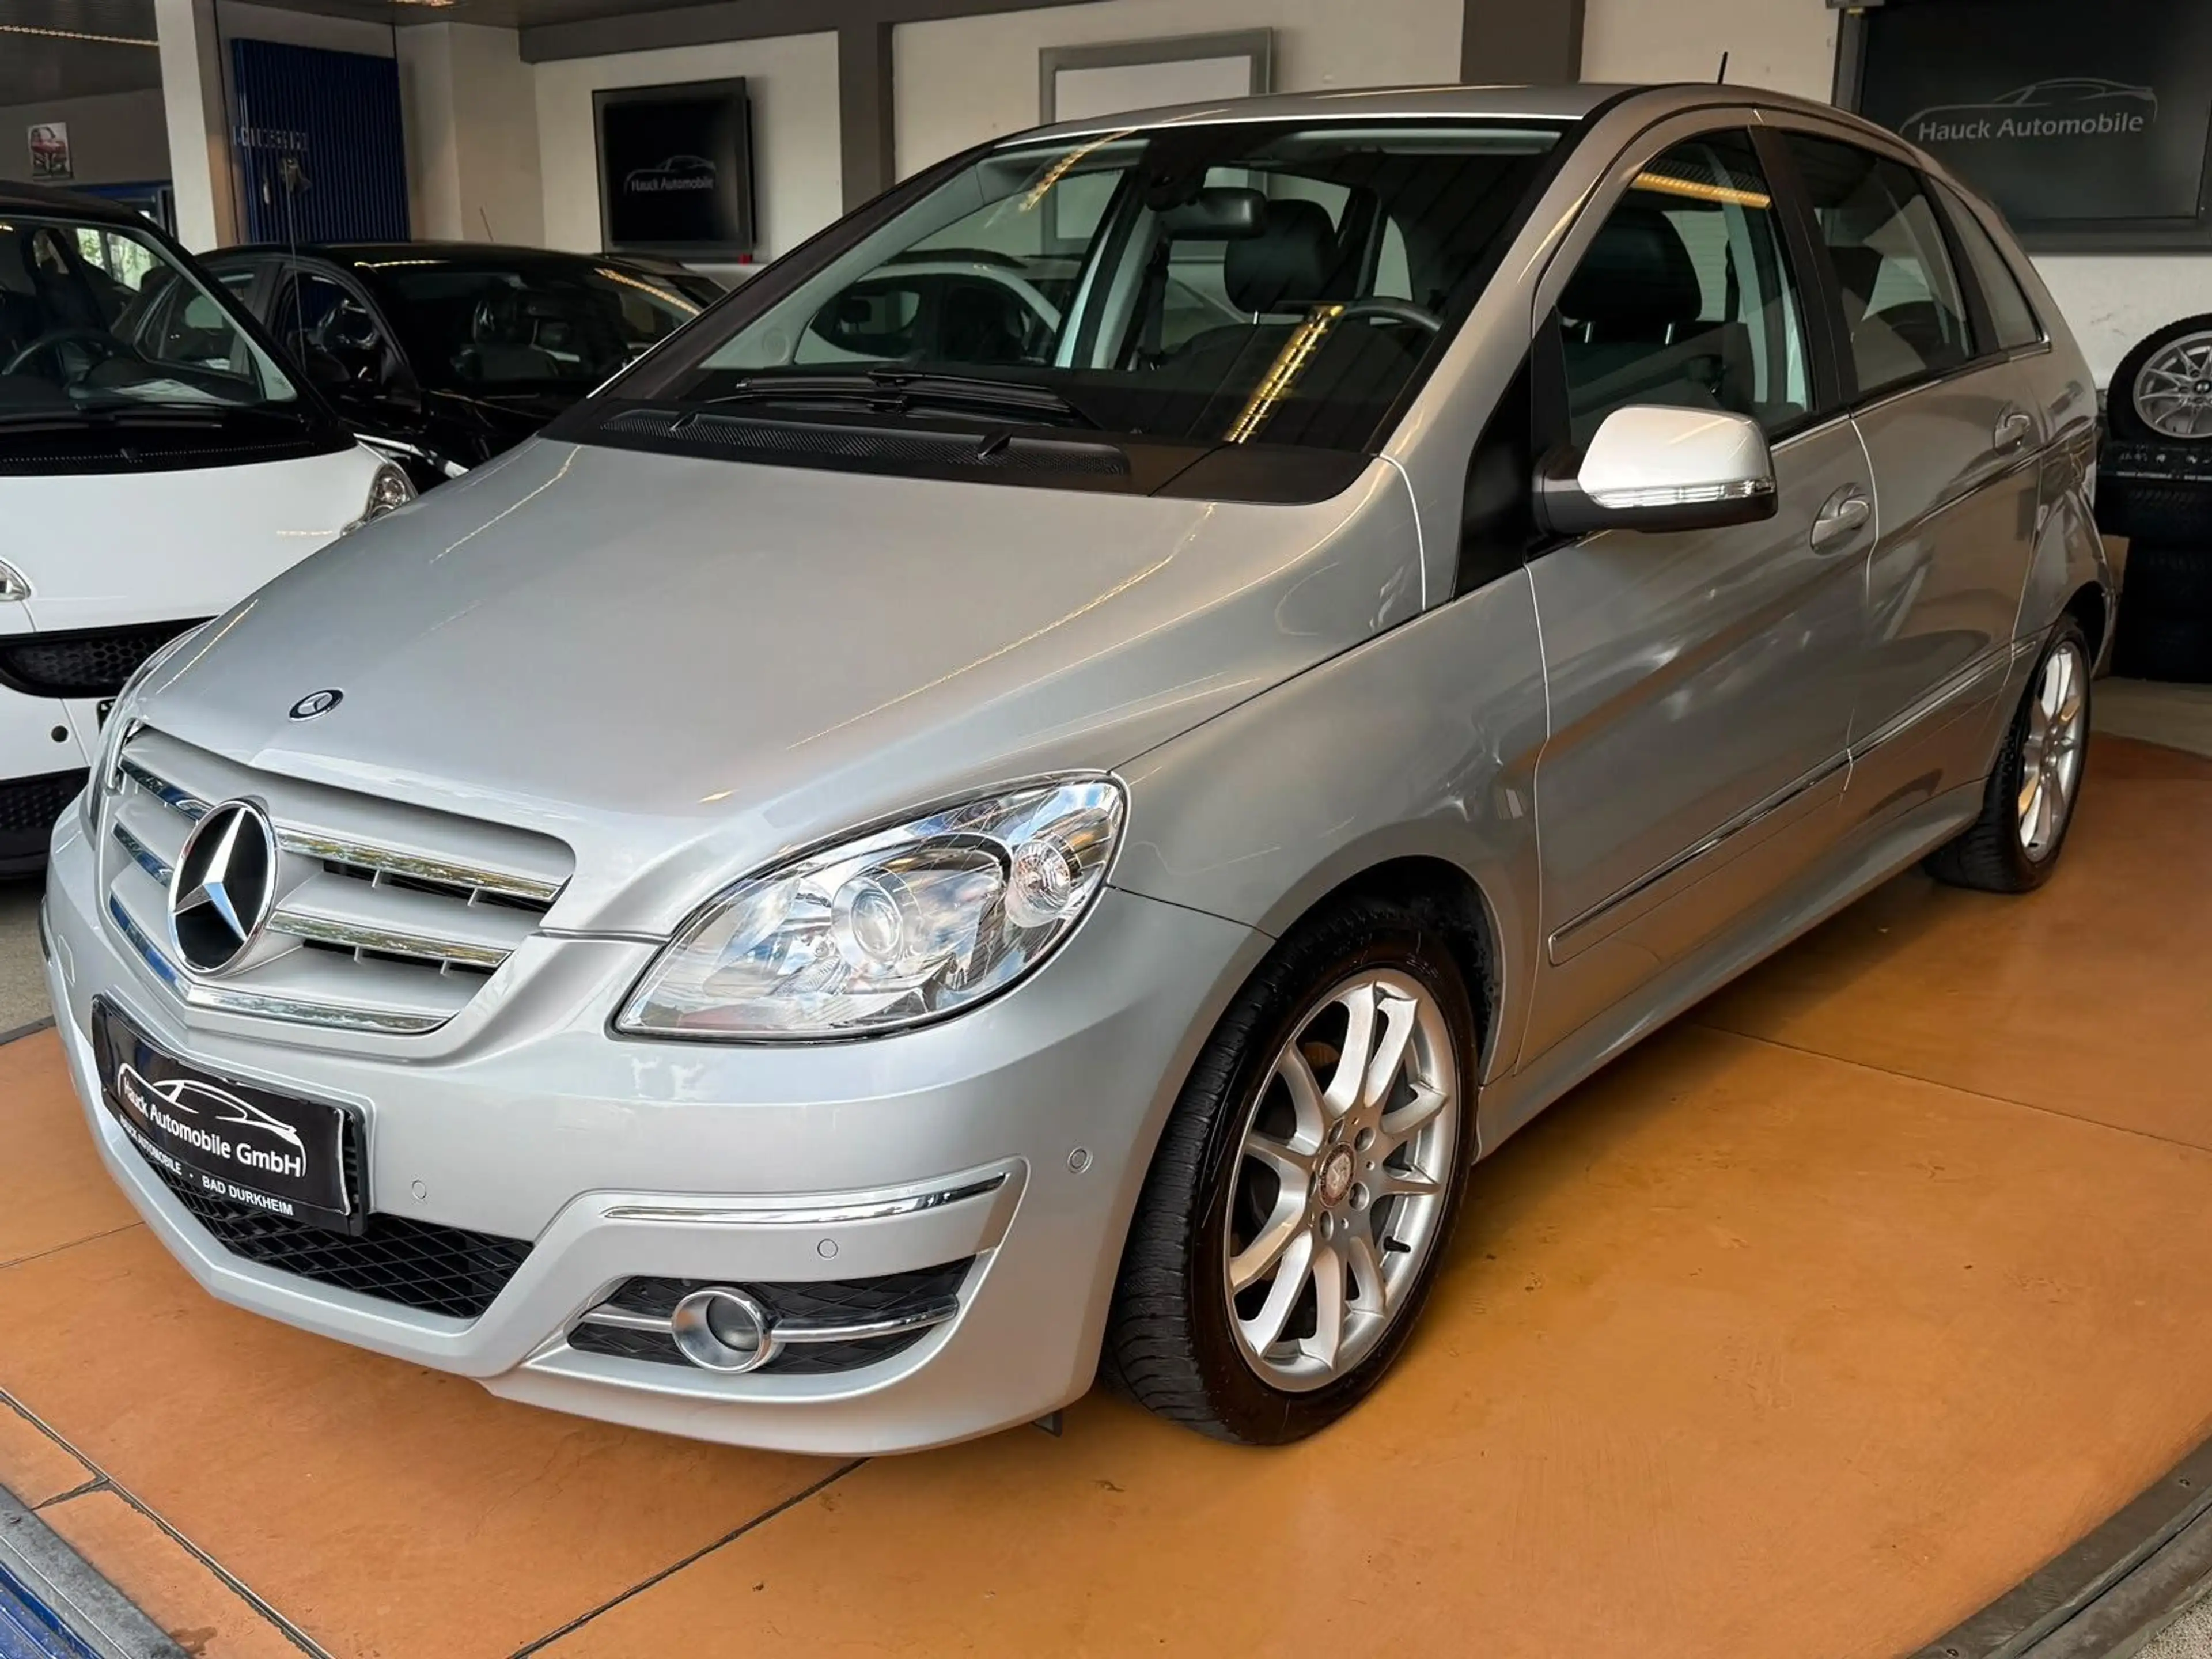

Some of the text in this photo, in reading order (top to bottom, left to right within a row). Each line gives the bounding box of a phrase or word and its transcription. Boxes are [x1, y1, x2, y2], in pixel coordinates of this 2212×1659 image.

[1919, 112, 2144, 141] Hauck Automobile
[631, 176, 713, 192] Hauck Automobile
[124, 1075, 301, 1177] Hauck Automobile GmbH
[202, 1175, 226, 1194] BAD
